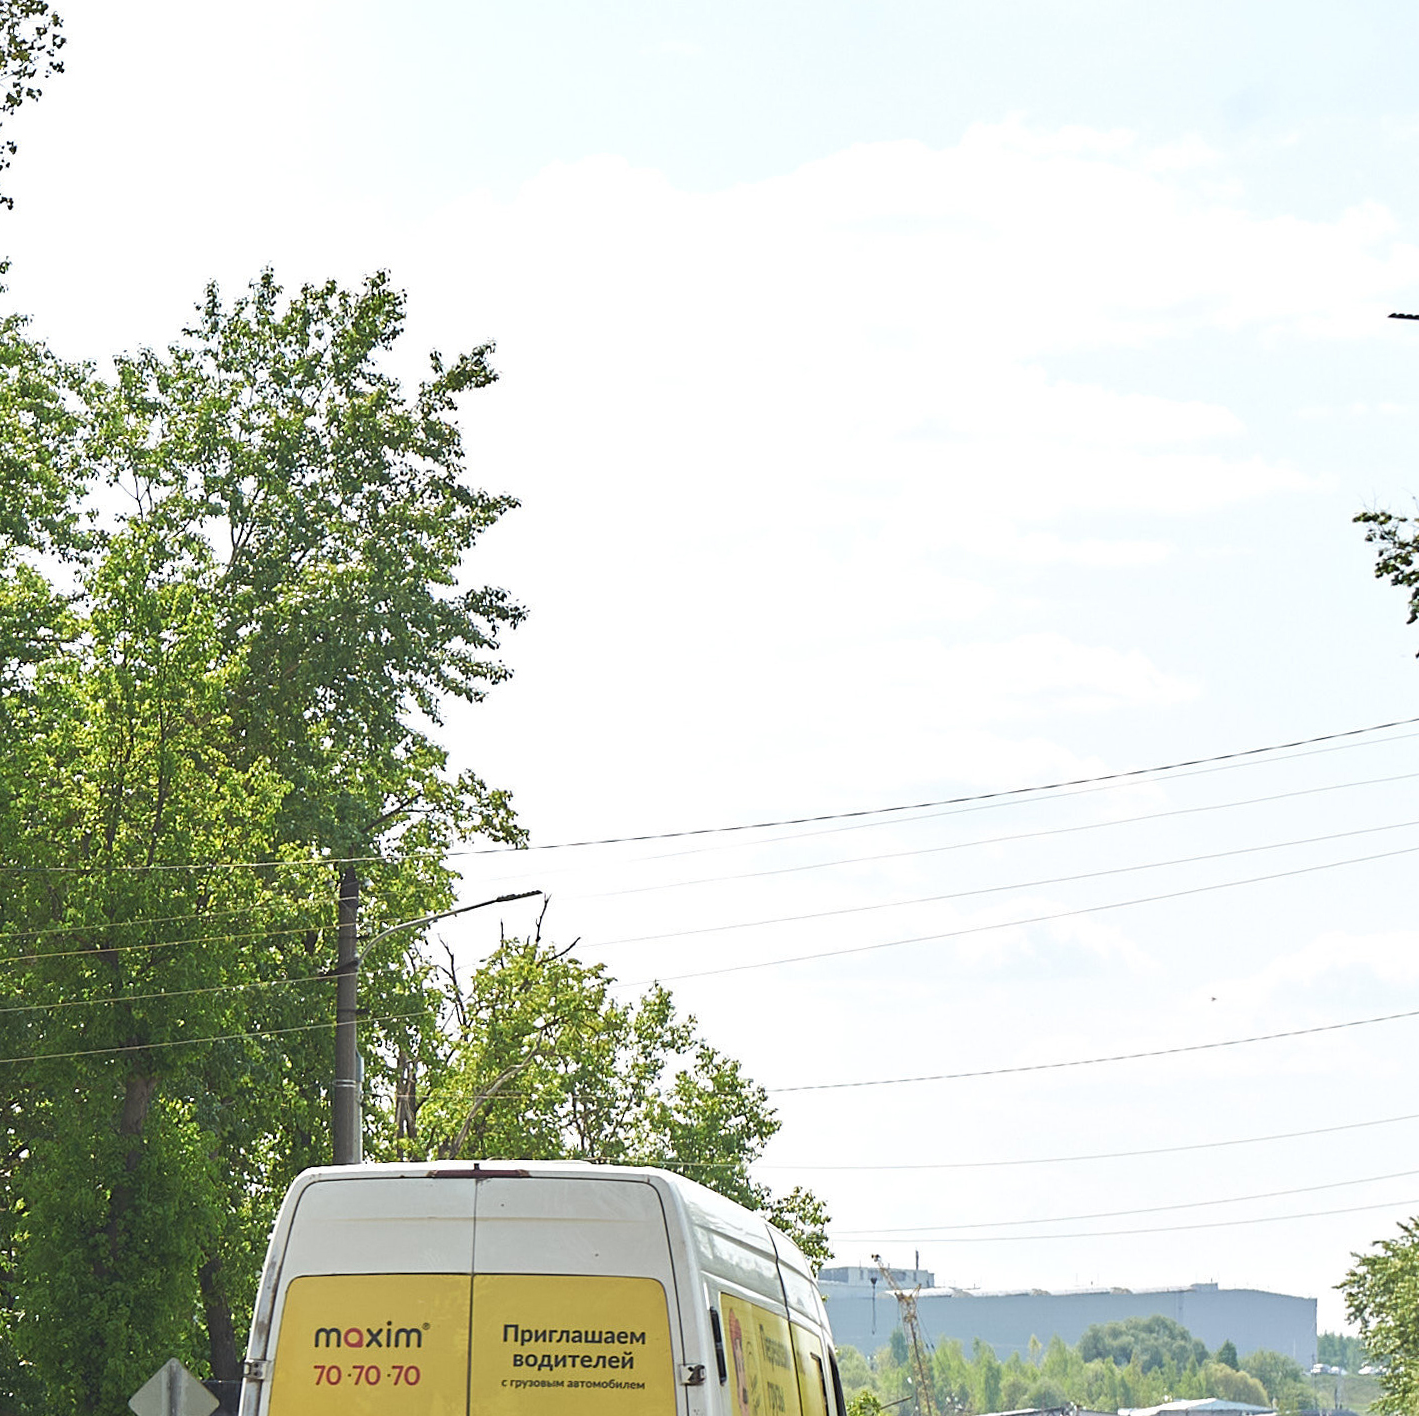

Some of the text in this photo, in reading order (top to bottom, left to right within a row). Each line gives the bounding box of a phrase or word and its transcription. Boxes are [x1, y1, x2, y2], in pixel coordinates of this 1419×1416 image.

[502, 1323, 647, 1346] Приглашаем
[513, 1351, 634, 1371] водителей
[501, 1378, 646, 1390] с грузовым автомобилем
